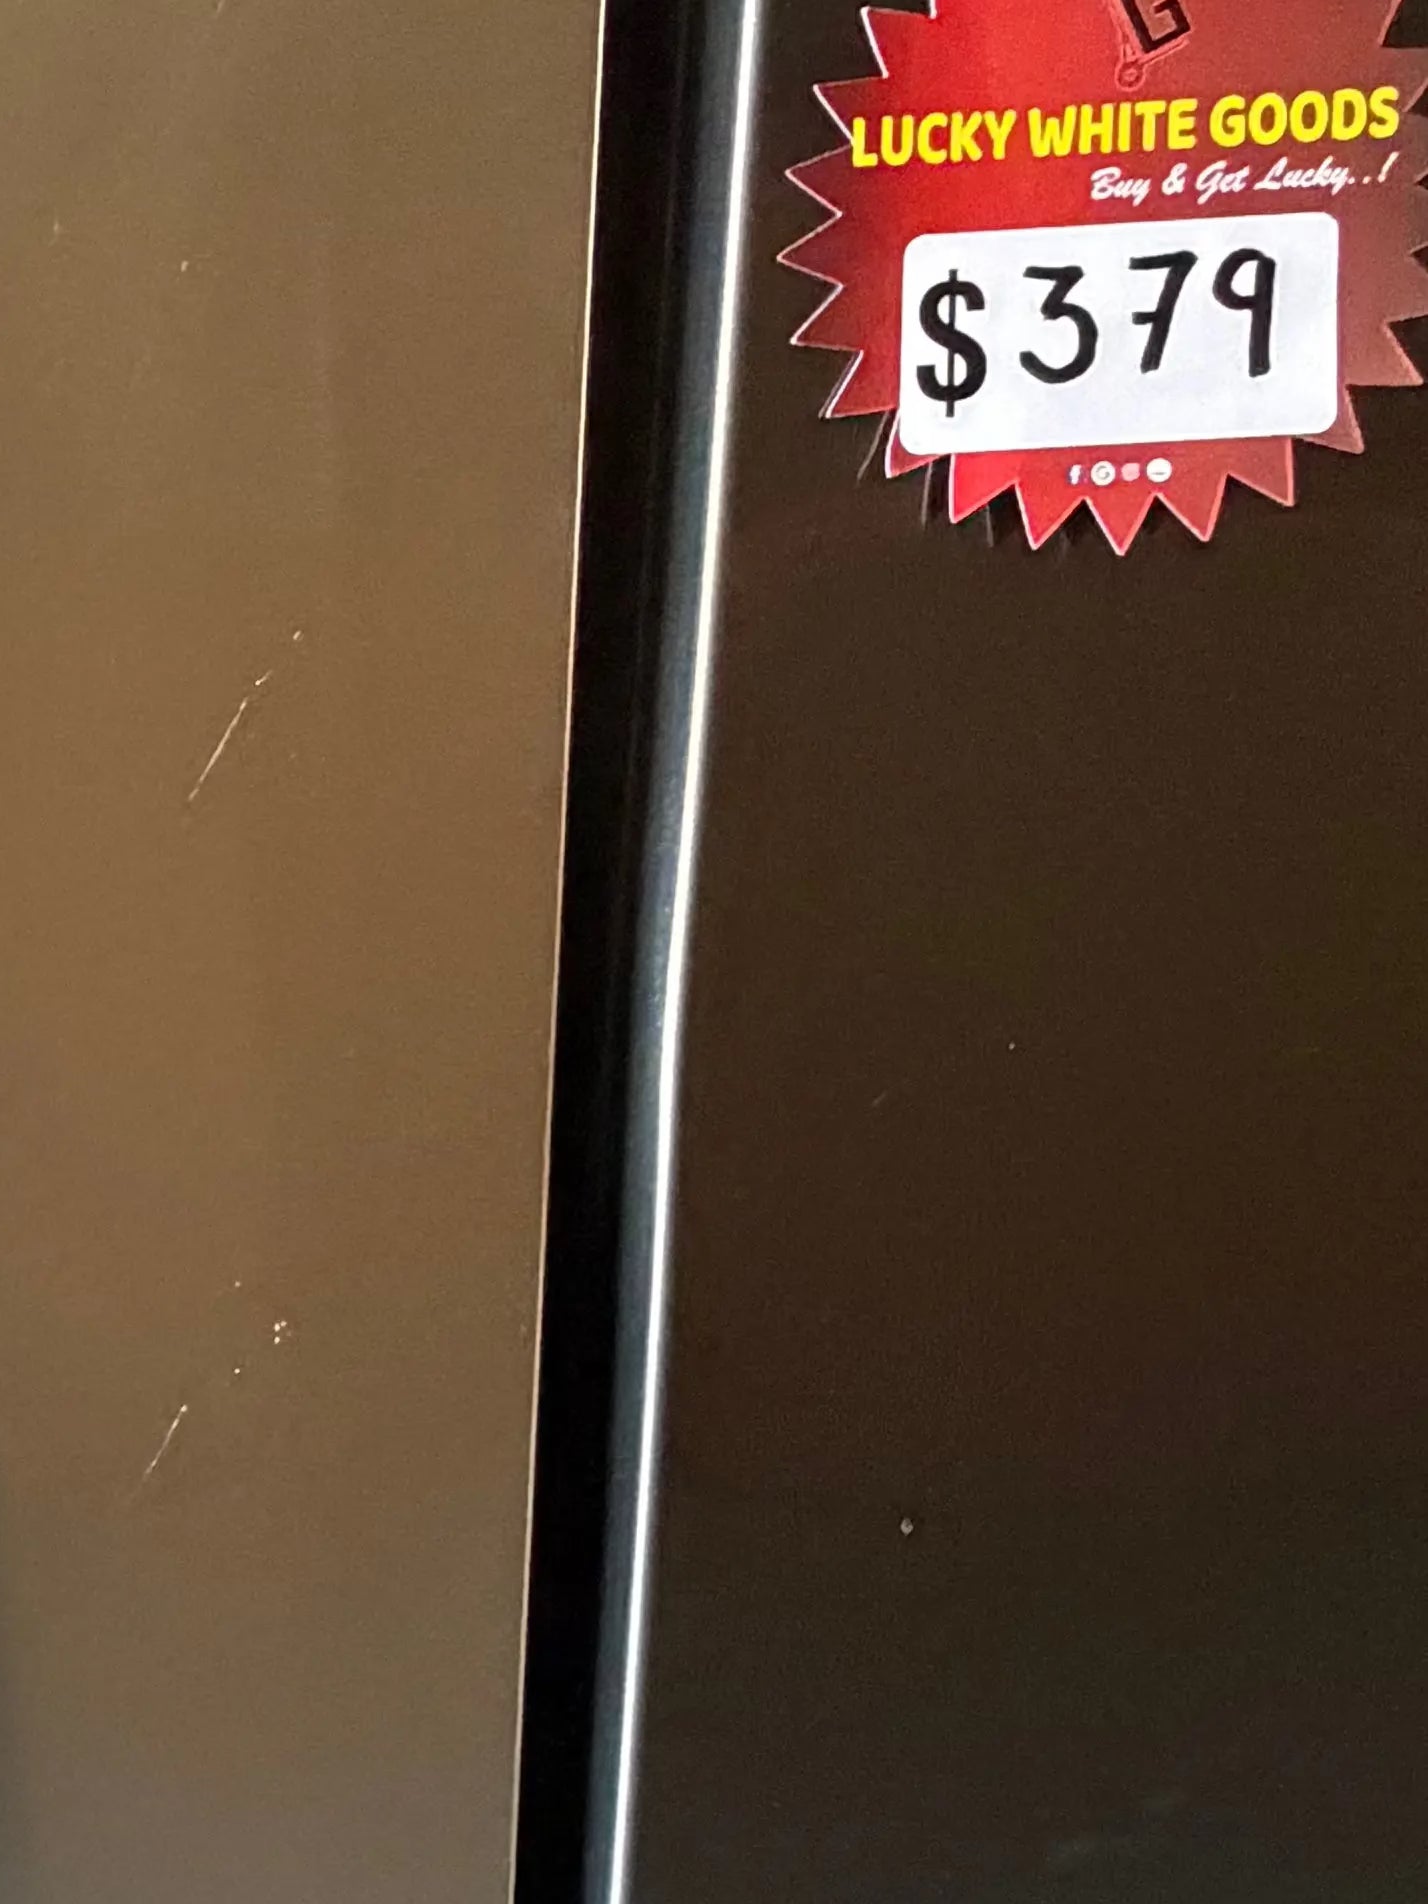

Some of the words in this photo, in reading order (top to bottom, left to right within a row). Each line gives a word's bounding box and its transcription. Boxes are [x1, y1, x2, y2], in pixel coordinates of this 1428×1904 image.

[851, 110, 1017, 168] LUCKY
[1029, 101, 1196, 159] WHITE
[1209, 87, 1400, 149] GOODS
[1090, 168, 1150, 204] Buy
[1162, 168, 1186, 194] &
[1196, 162, 1248, 205] Get
